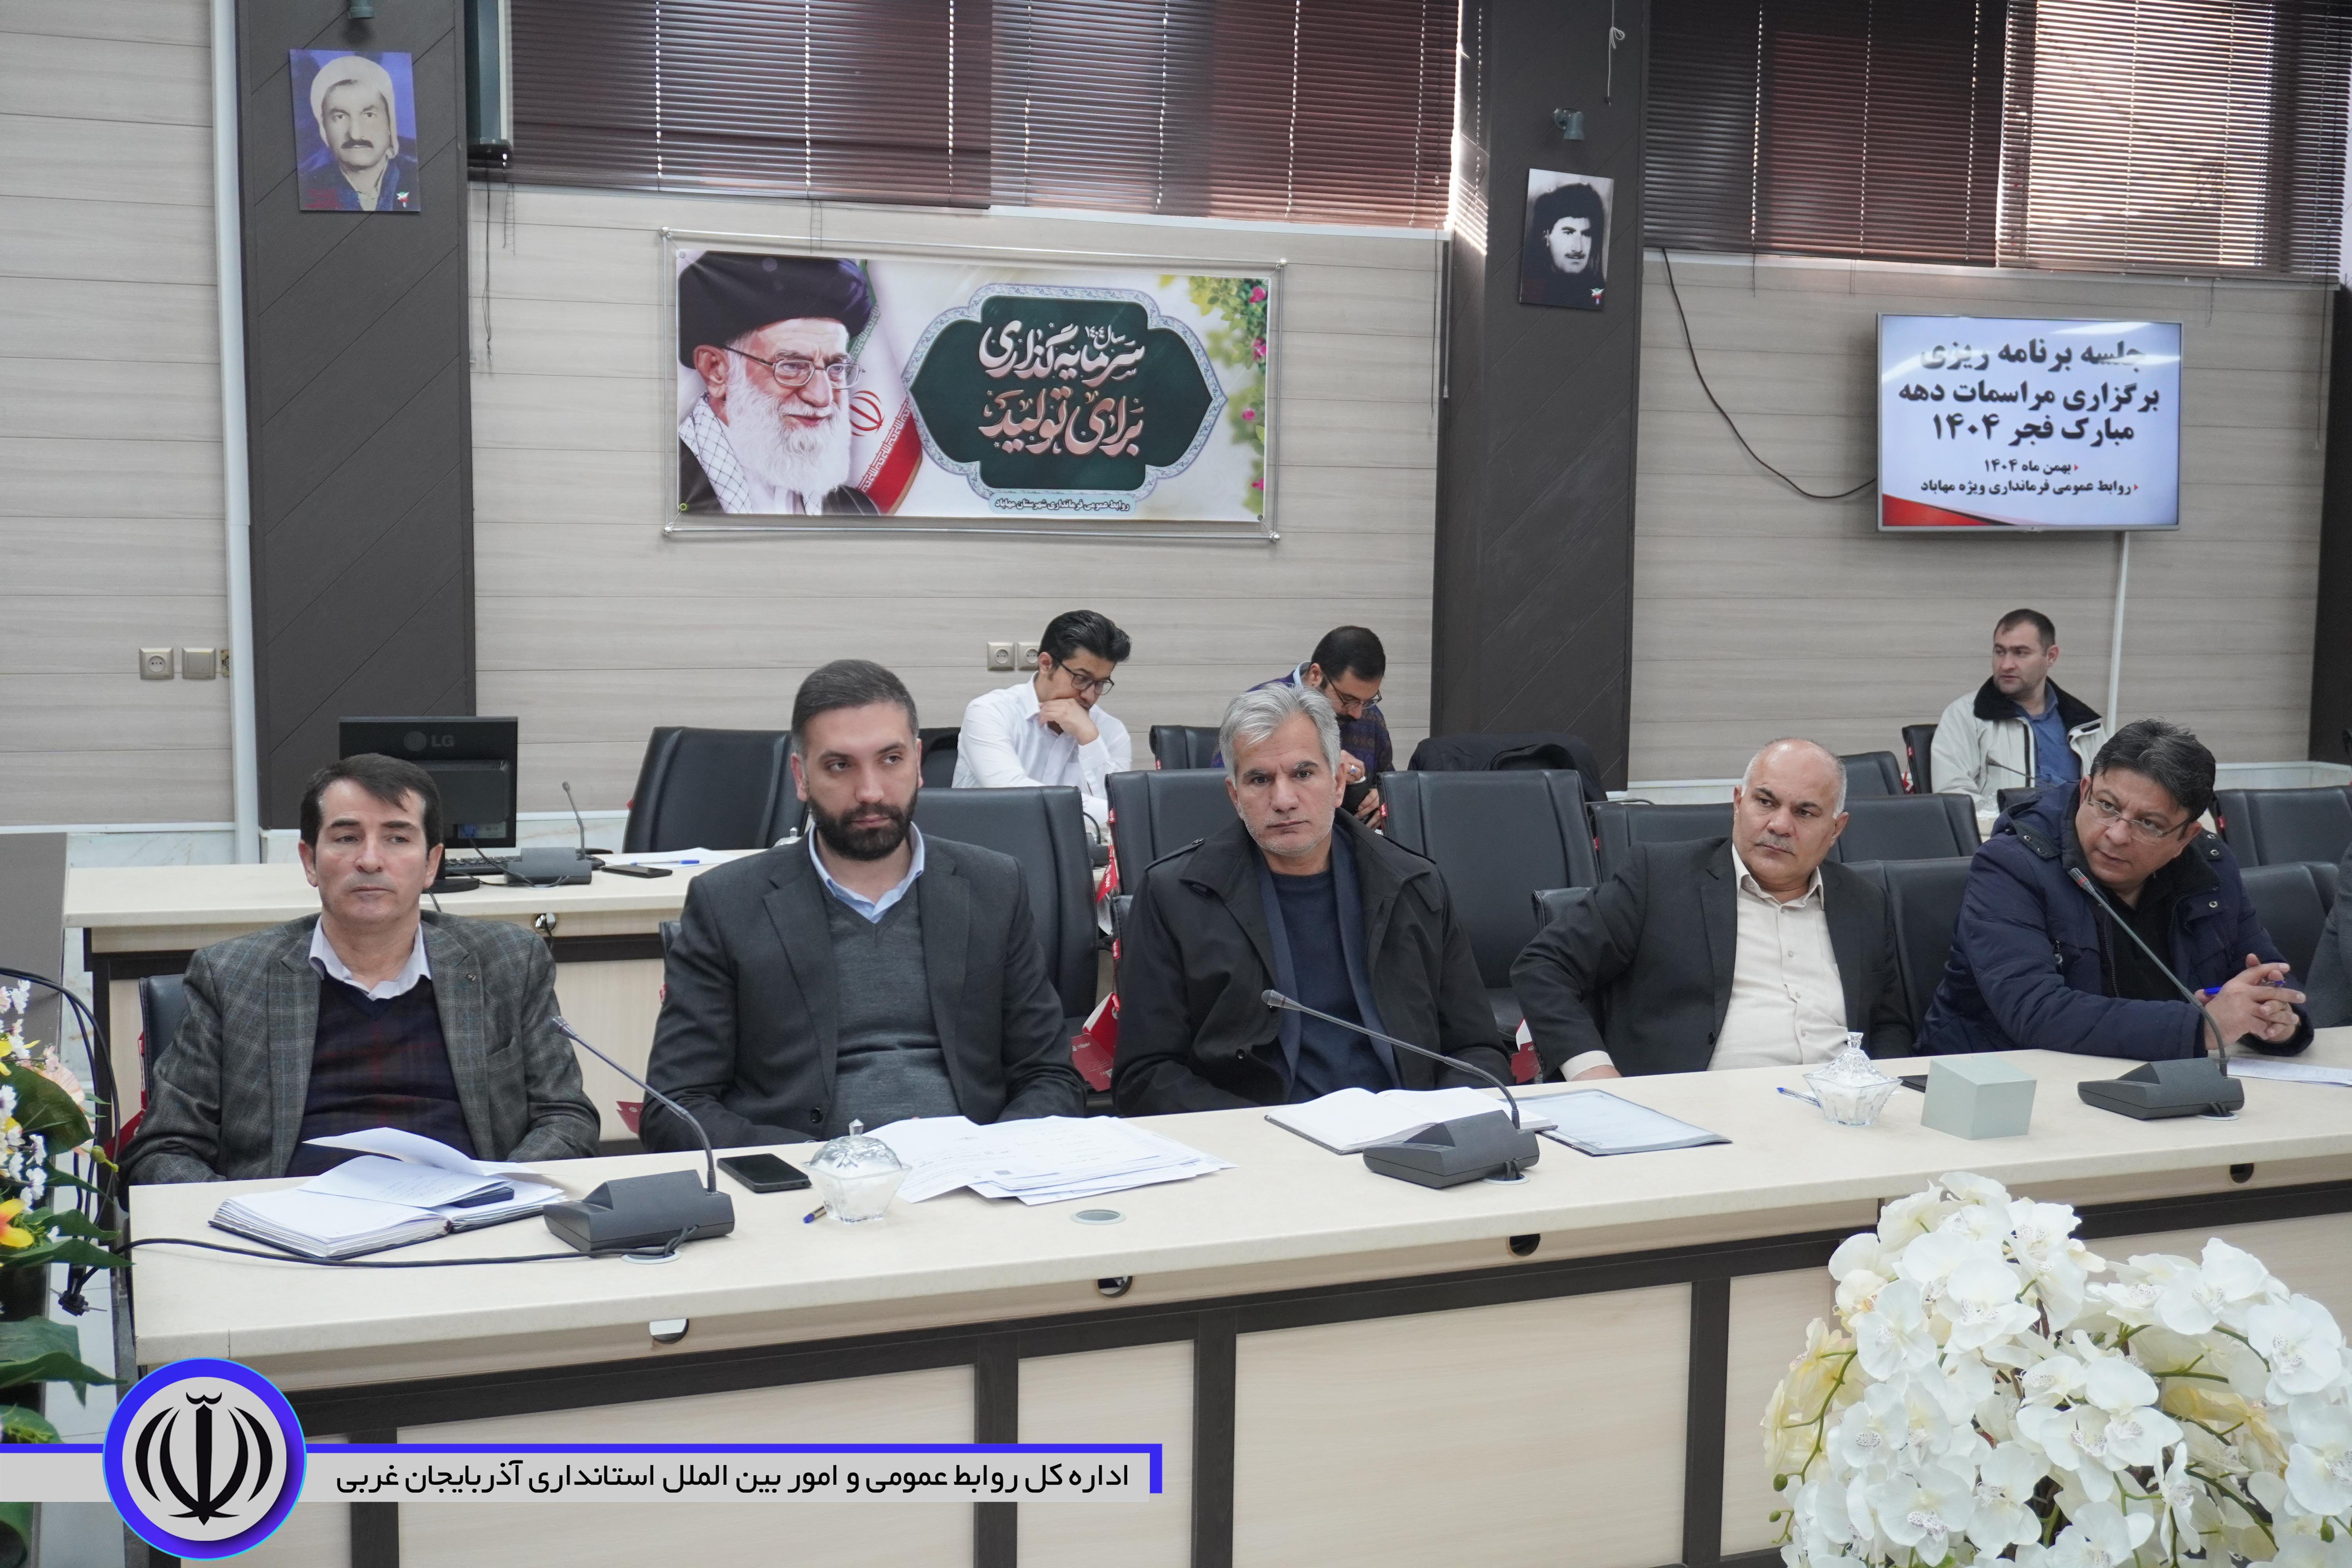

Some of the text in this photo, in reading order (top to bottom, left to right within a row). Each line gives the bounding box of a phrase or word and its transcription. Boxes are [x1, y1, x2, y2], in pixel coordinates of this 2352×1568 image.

[1920, 341, 1990, 370] ریزی
[1998, 338, 2073, 372] برنامه
[1898, 379, 2160, 412] برگزاری مراسمات دهه
[1933, 412, 2134, 447] مبارک فجر ۱۴۰۴
[1984, 459, 2072, 475] بهمن ماه ۱۴۰۴
[1920, 479, 2131, 495] روابط عمومی فرمانداری ویژه مهاباد
[995, 498, 1016, 509] مهاباد
[1047, 498, 1083, 511] فرمانداری
[1083, 501, 1109, 511] عمومی
[1109, 500, 1129, 511] روابط
[431, 735, 455, 747] LG
